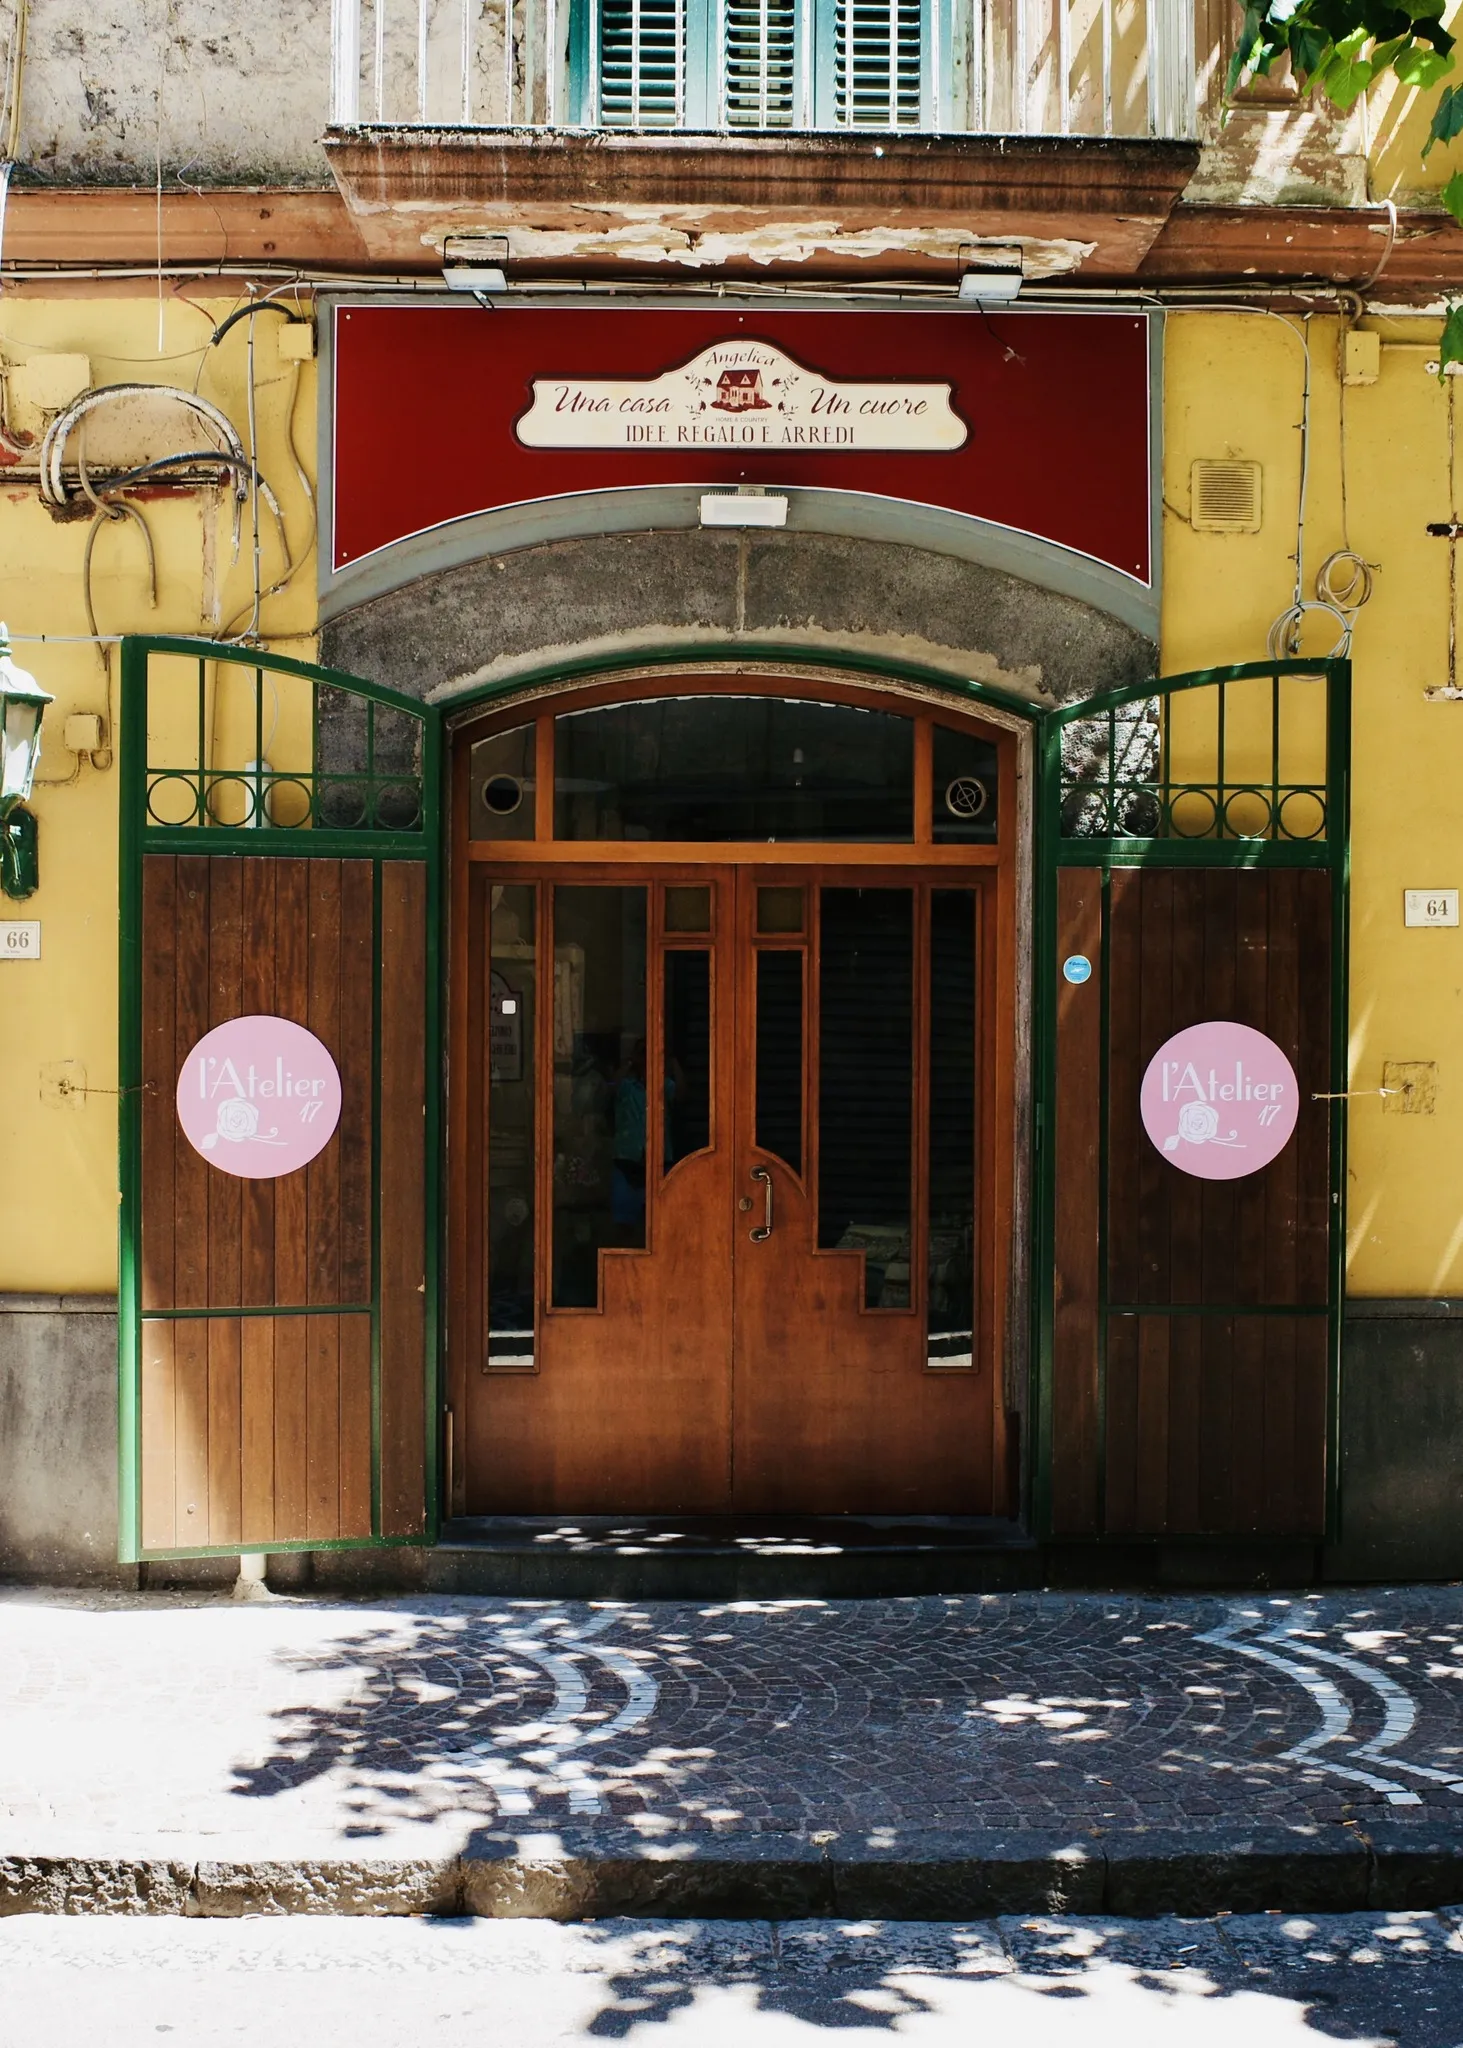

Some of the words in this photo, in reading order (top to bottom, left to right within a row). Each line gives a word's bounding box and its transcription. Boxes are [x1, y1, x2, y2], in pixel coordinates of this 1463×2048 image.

[705, 347, 779, 369] Angelica
[555, 385, 613, 413] Una
[619, 397, 674, 413] casa
[810, 387, 852, 414] Un
[859, 398, 929, 416] cuore
[626, 424, 670, 442] IDEE
[677, 425, 754, 443] REGALO
[762, 426, 774, 443] E
[781, 426, 854, 444] ARREDI
[1427, 899, 1449, 916] 64
[6, 931, 29, 948] 66
[199, 1056, 326, 1099] l'Atelier
[1162, 1061, 1284, 1101] l'Atelier
[299, 1101, 323, 1123] 17
[1258, 1105, 1281, 1126] 17
